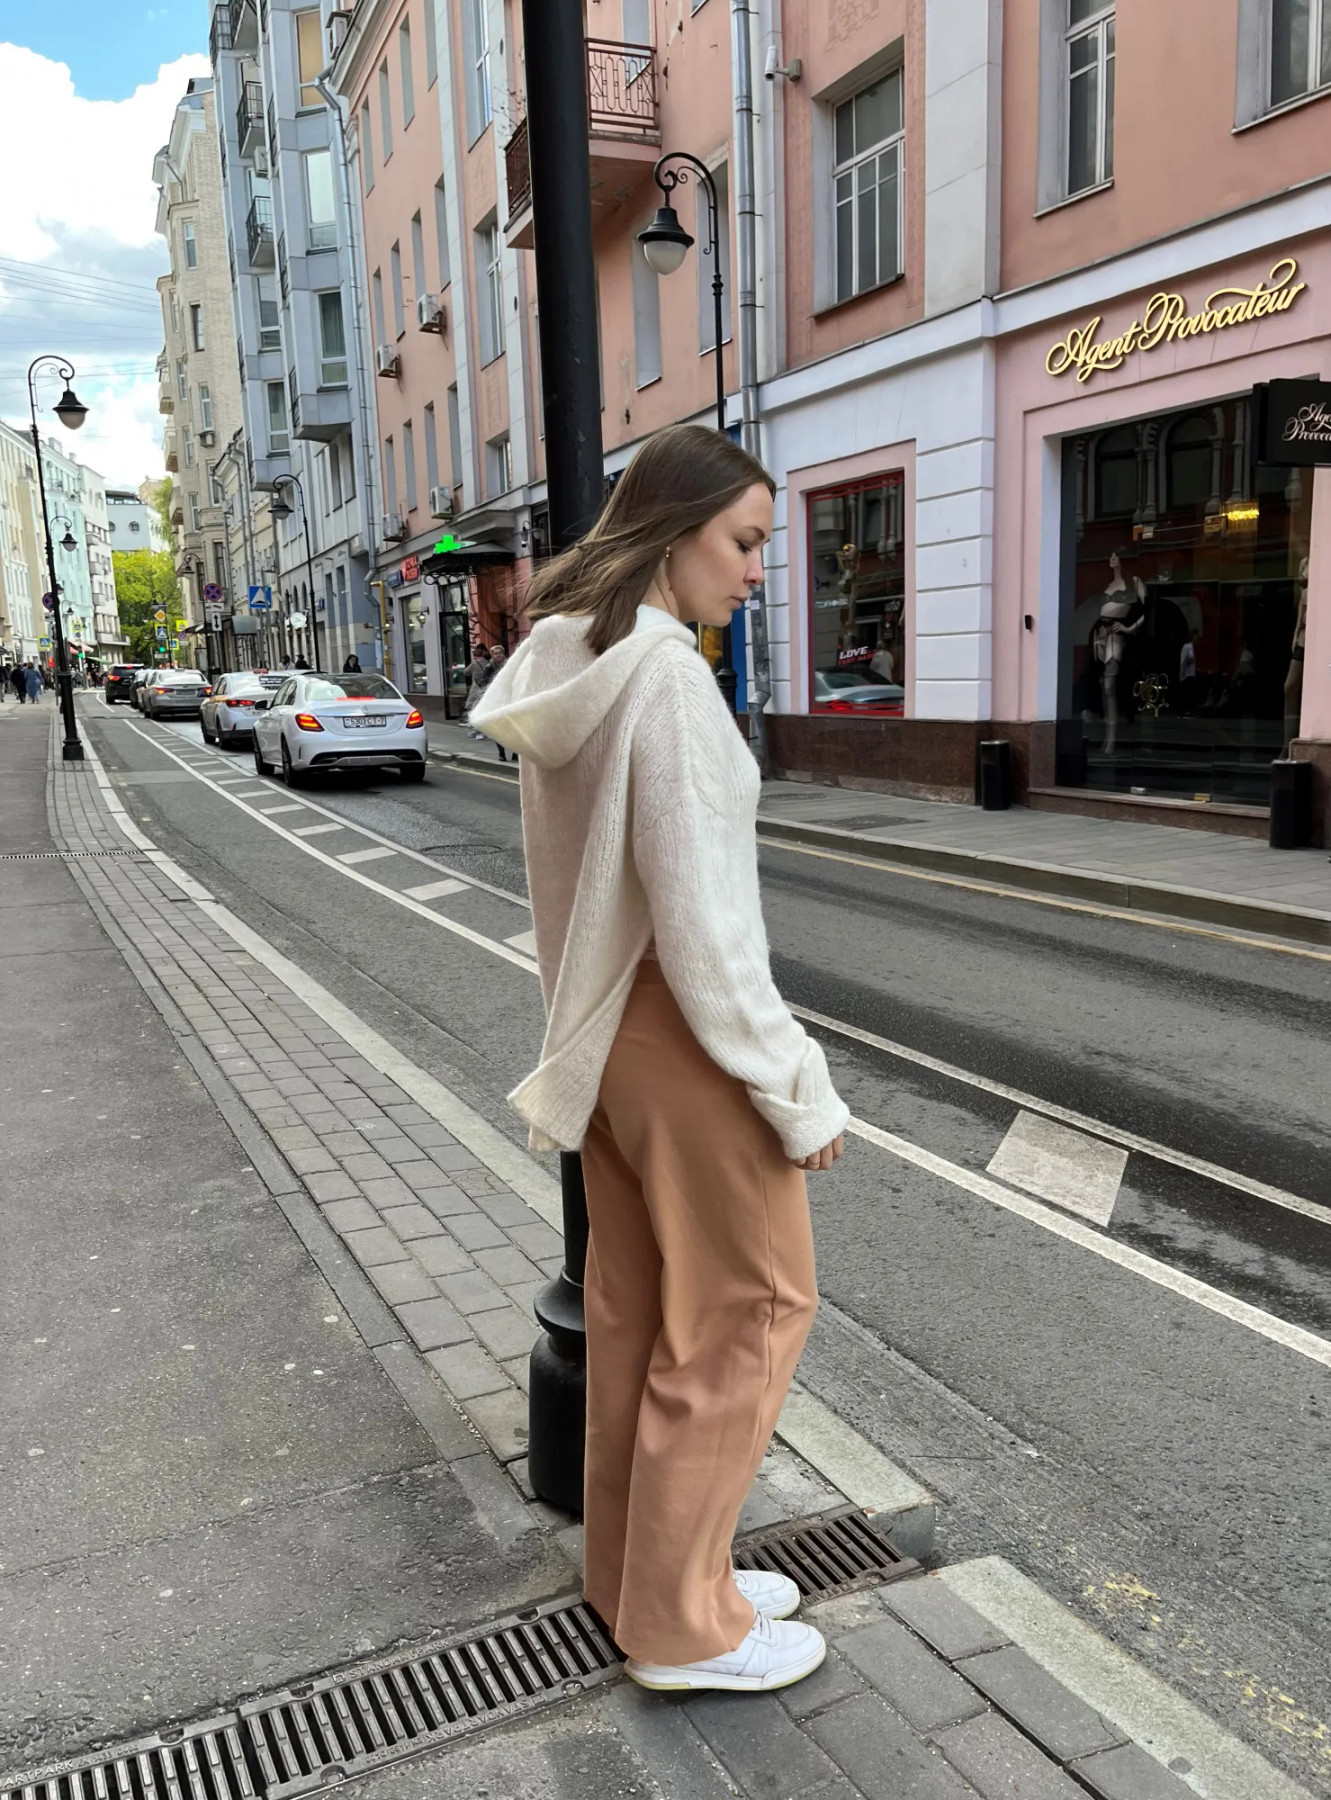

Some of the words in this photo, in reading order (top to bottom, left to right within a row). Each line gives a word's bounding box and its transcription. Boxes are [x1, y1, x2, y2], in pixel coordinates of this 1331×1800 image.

[1046, 316, 1141, 382] Agent
[1138, 258, 1308, 349] Provocateur
[1298, 402, 1331, 431] Age
[839, 646, 869, 660] LOVE
